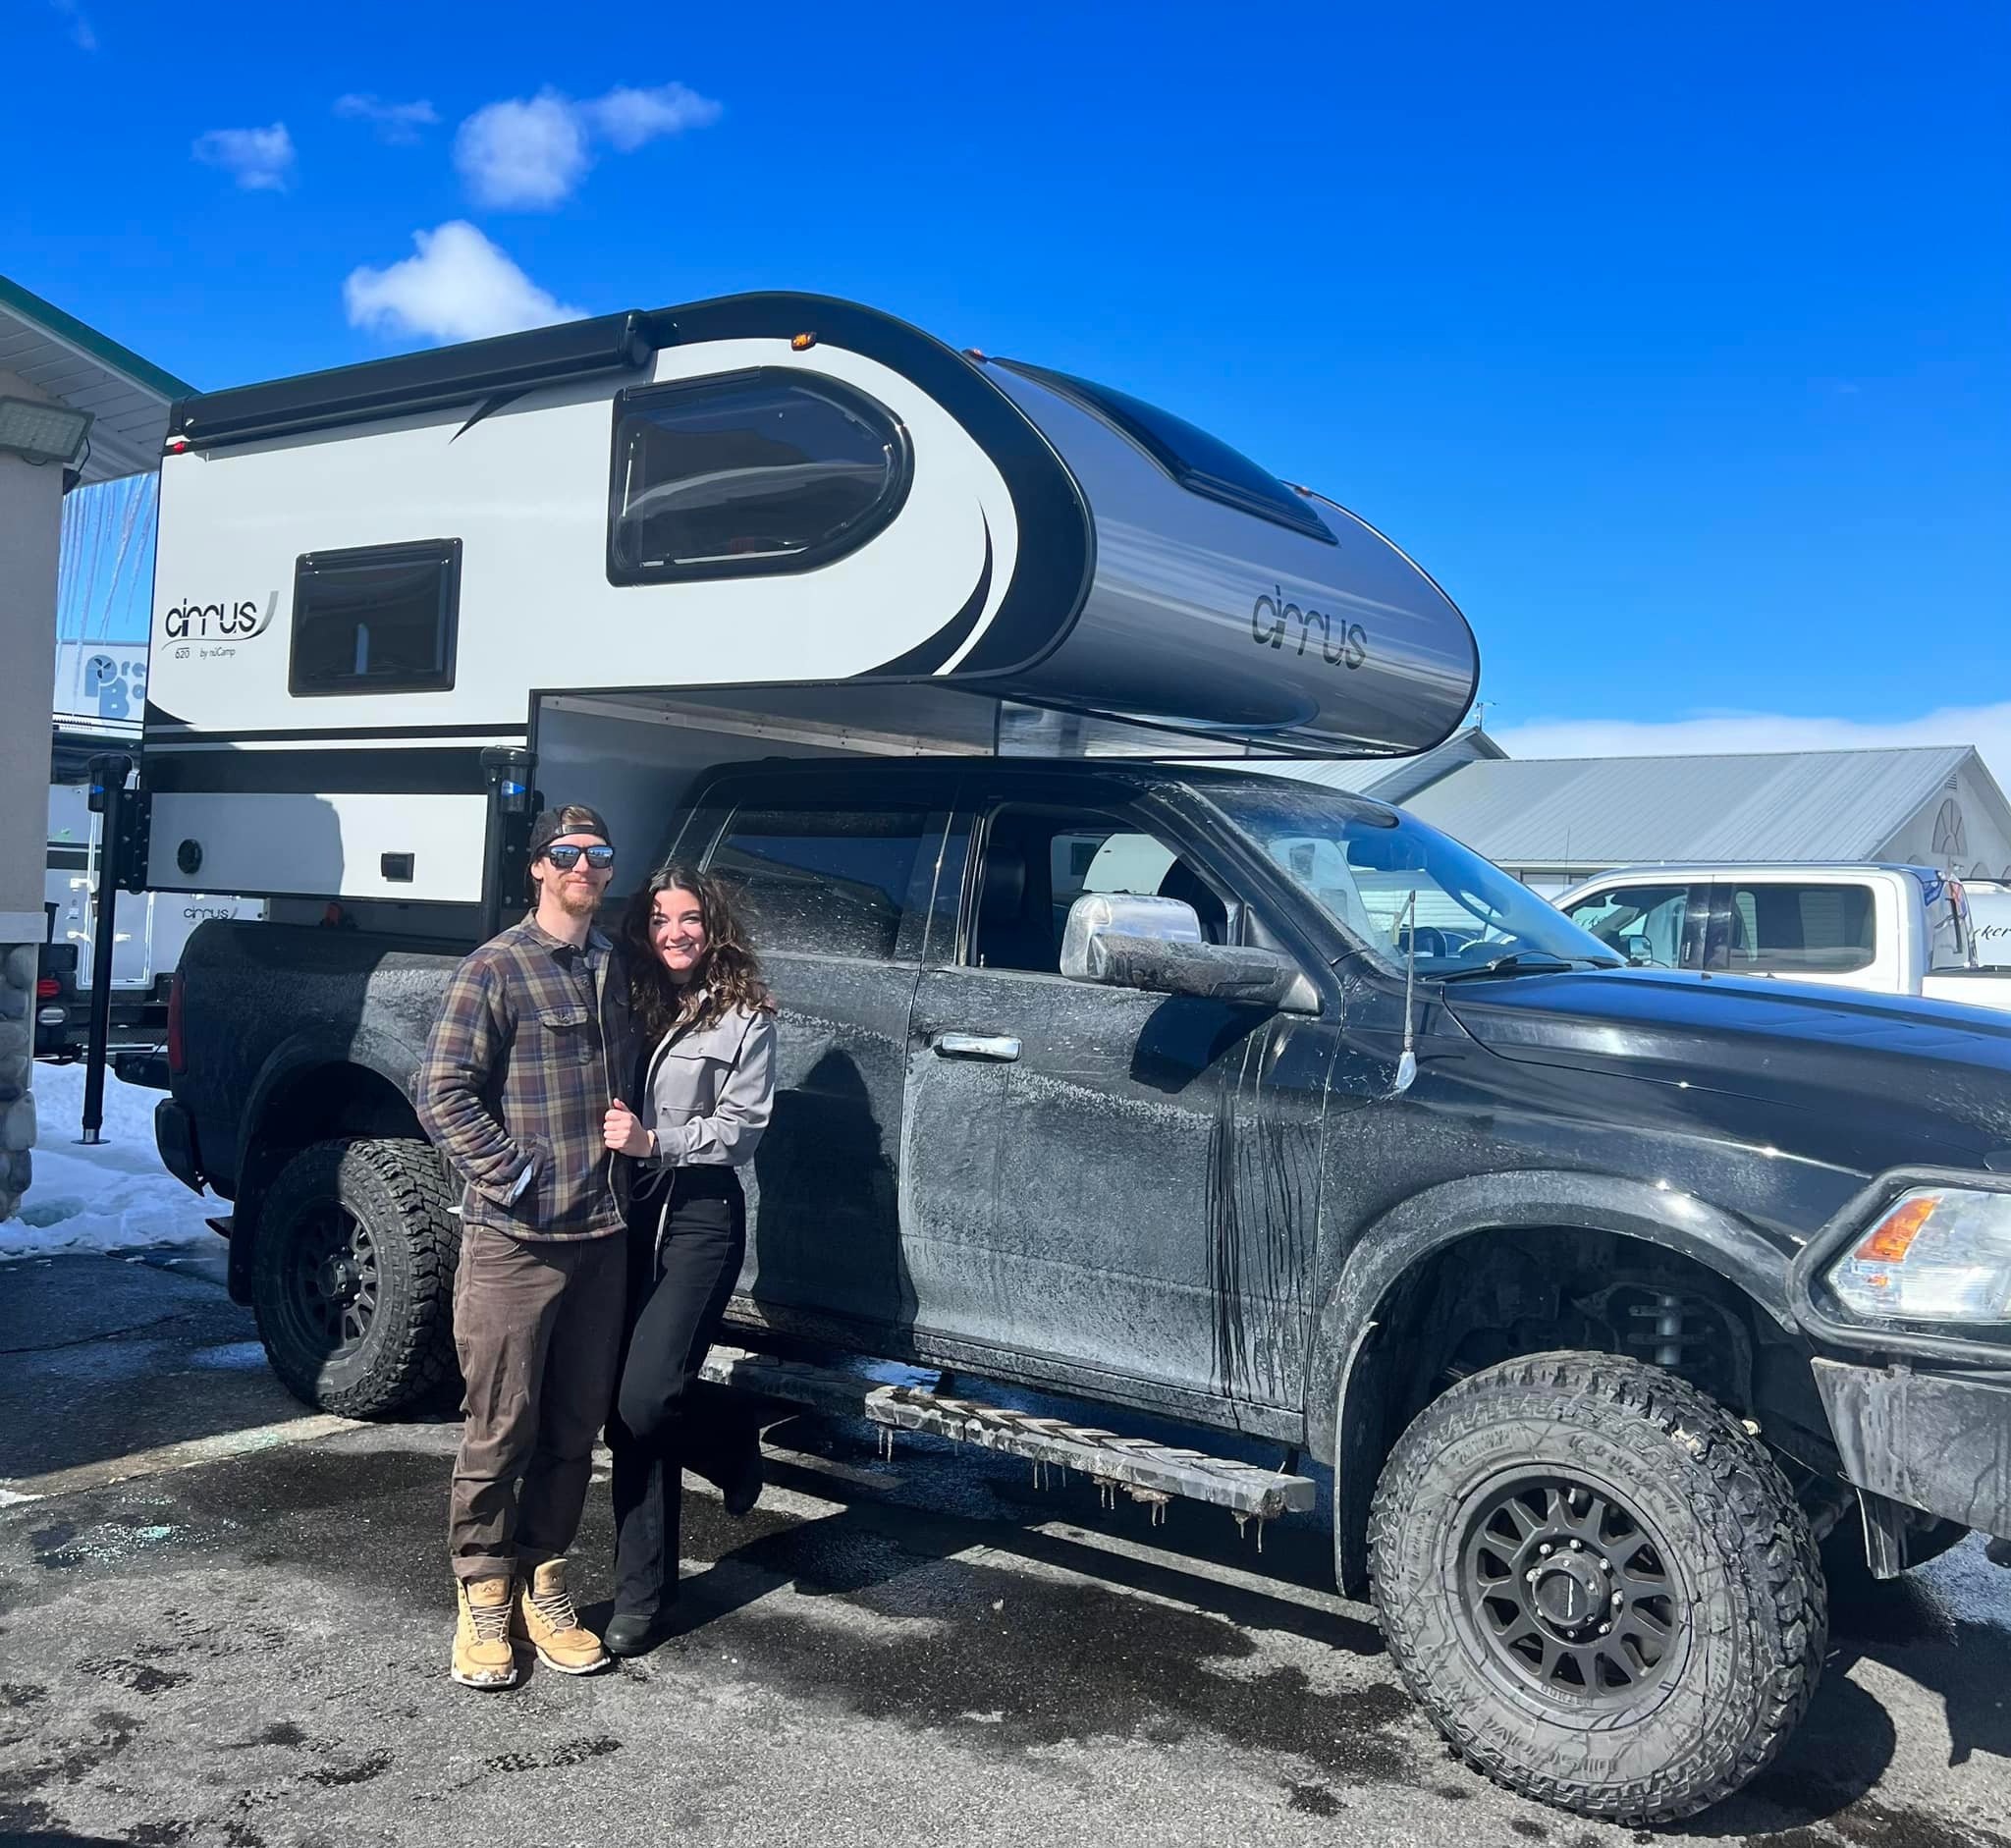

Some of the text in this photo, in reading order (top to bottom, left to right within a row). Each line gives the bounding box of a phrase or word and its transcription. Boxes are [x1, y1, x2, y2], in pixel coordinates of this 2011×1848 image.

[165, 597, 257, 638] cirrus
[1252, 584, 1368, 670] cirrus
[175, 647, 190, 660] 620
[199, 647, 208, 660] by
[183, 905, 229, 920] cirrus
